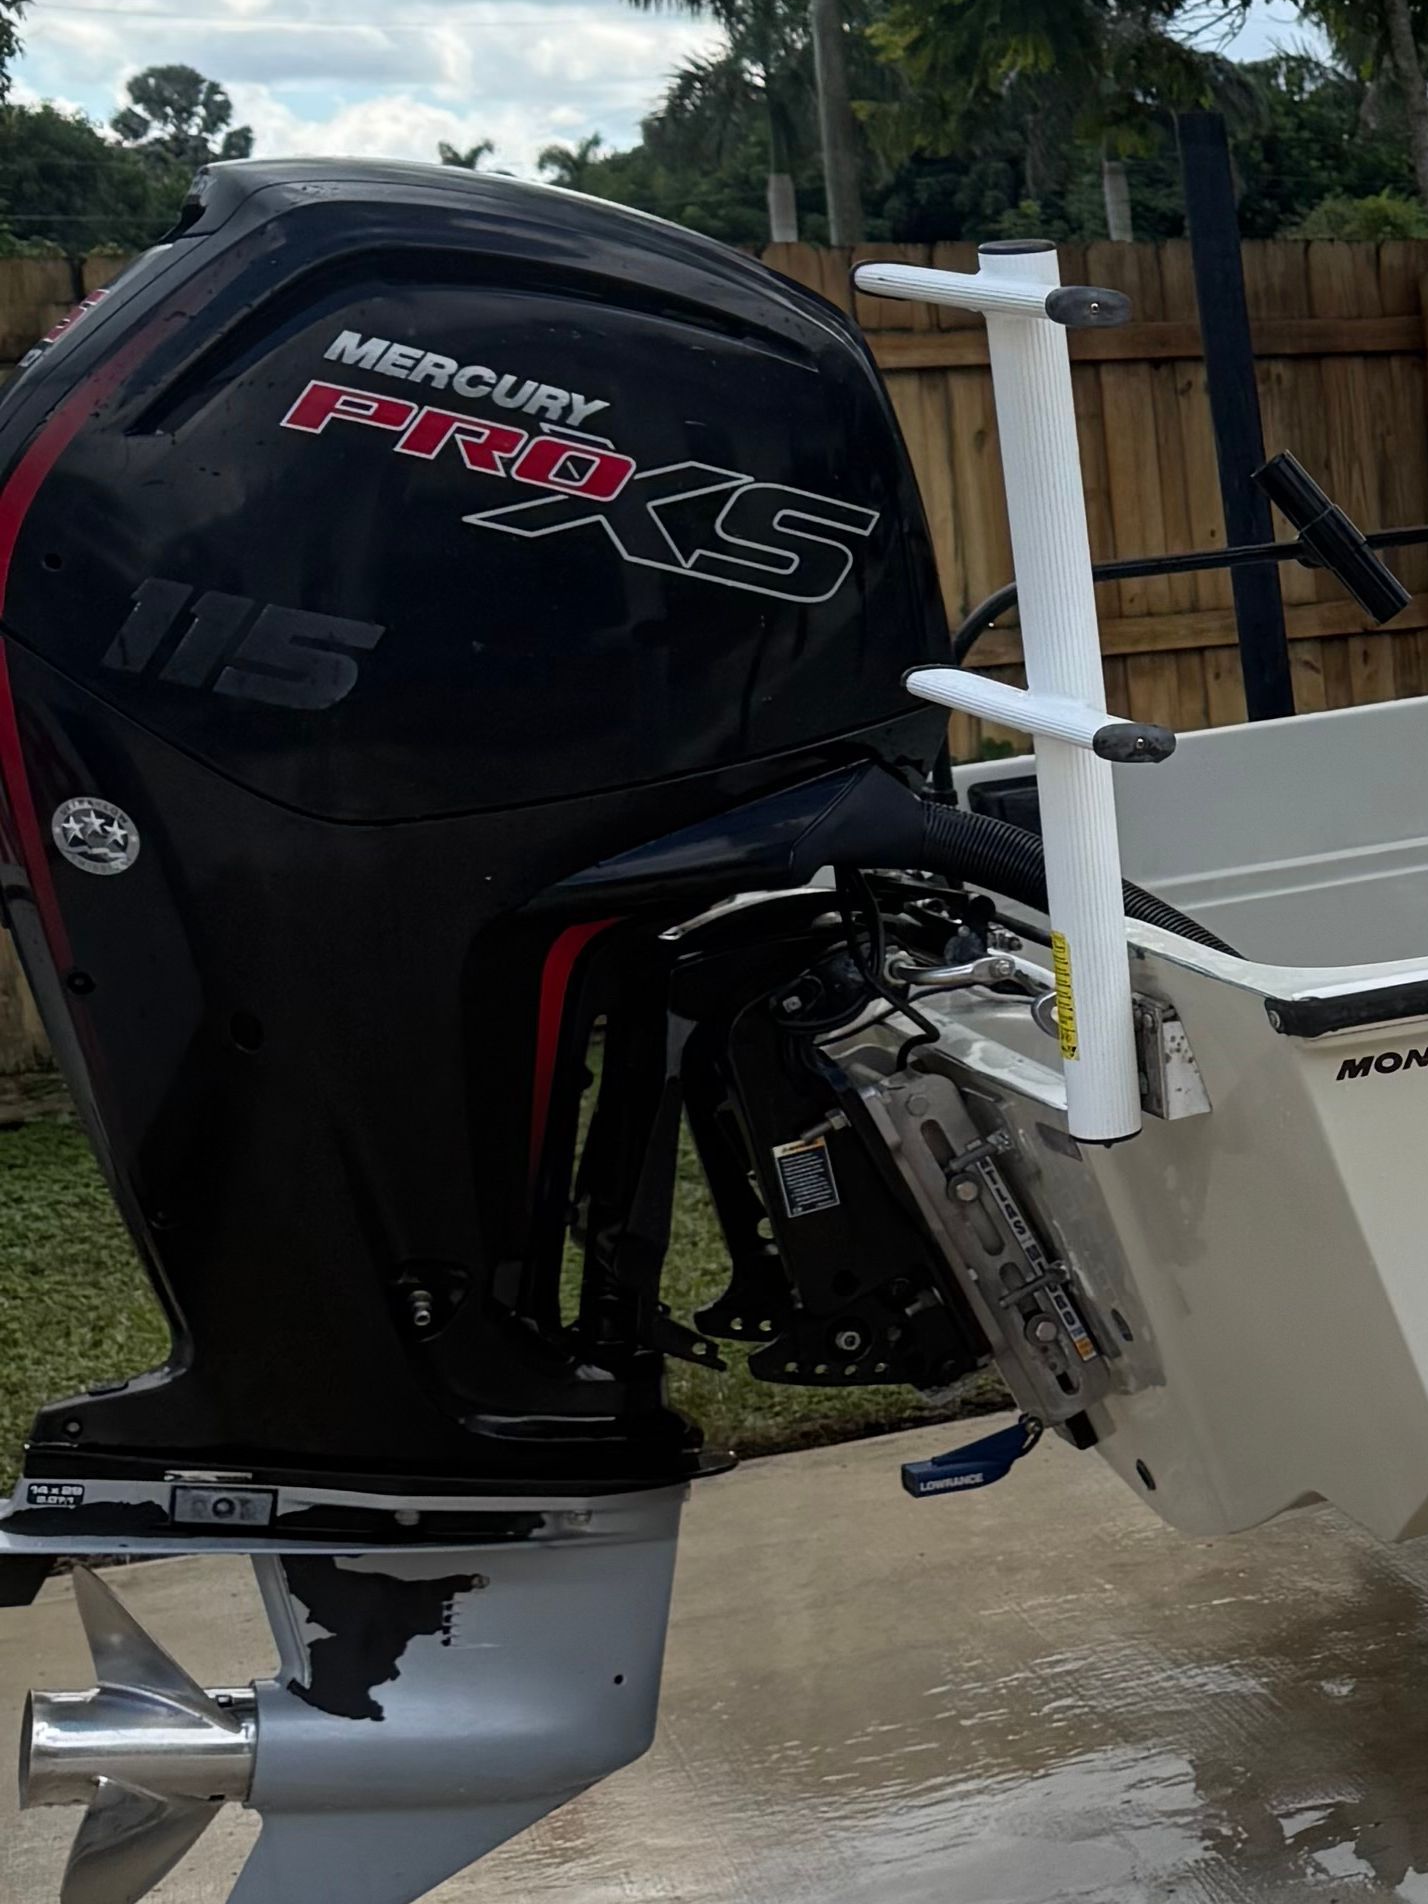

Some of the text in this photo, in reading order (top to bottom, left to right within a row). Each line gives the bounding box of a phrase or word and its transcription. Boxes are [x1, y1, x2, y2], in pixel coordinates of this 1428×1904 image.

[323, 330, 610, 426] MERCURY
[281, 379, 881, 604] PRO XS
[101, 577, 387, 710] 115
[920, 1473, 985, 1492] LOWRANCE
